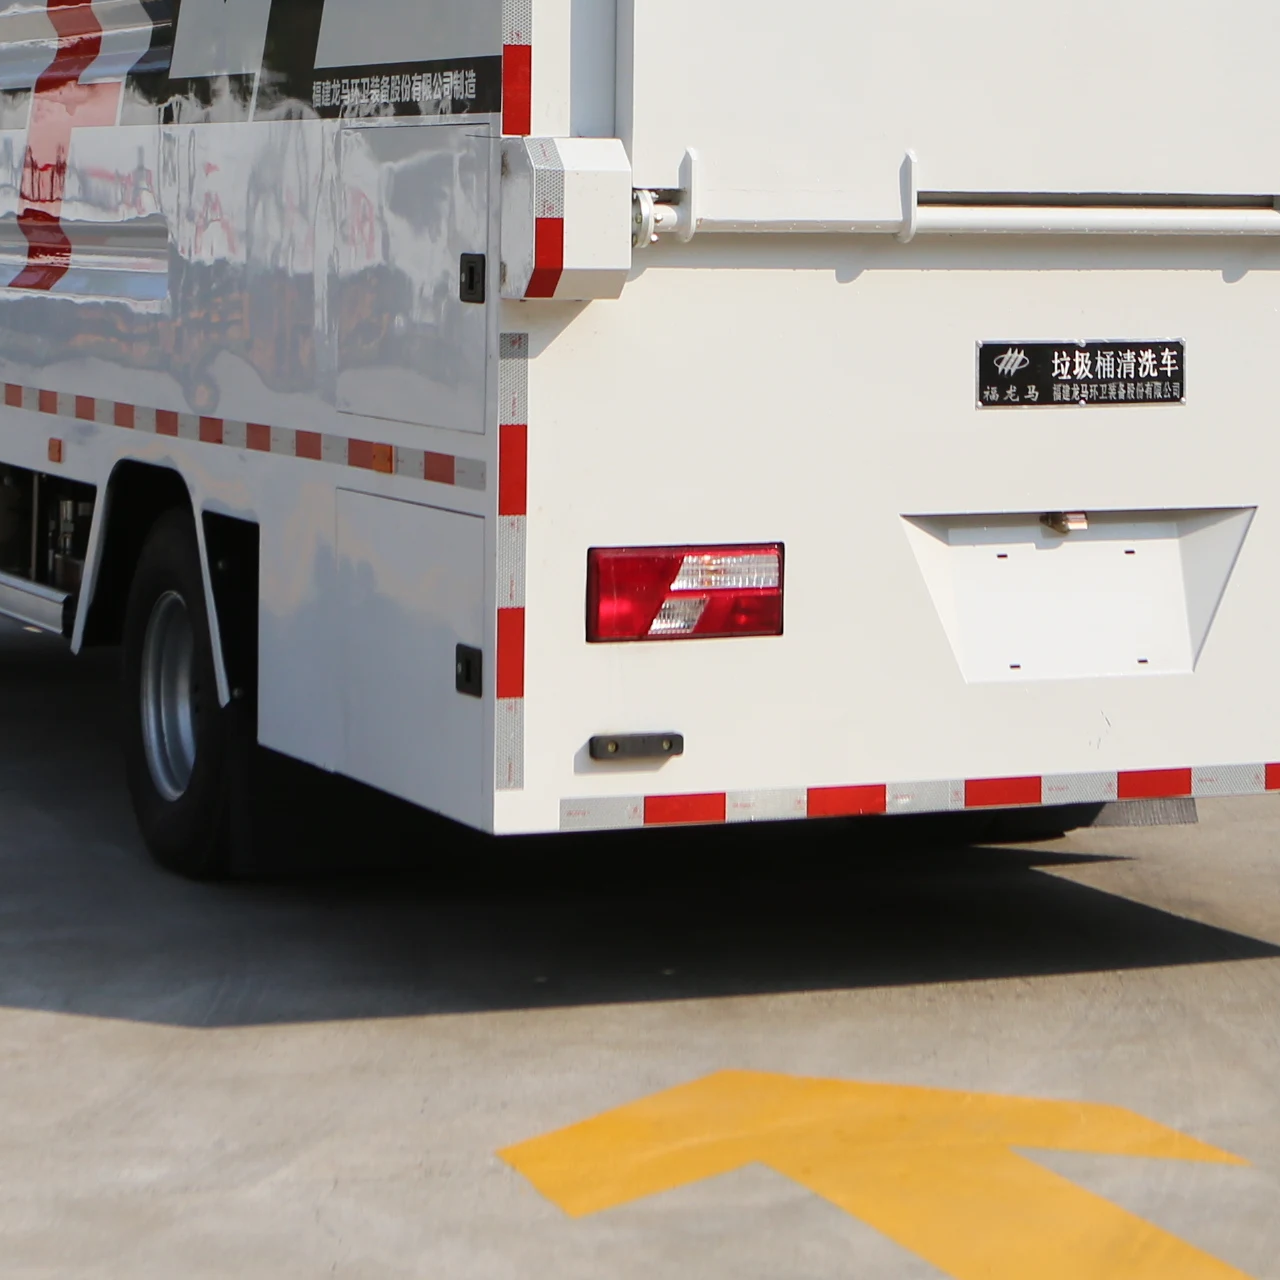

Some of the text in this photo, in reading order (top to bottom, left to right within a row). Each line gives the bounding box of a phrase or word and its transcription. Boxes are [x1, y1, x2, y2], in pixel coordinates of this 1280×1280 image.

[312, 69, 476, 108] 福建龙马环卫装备股份有限公司制造
[1051, 348, 1179, 380] 垃圾桶清洗车
[1052, 381, 1181, 402] 福建龙马环卫装备股份有限公司
